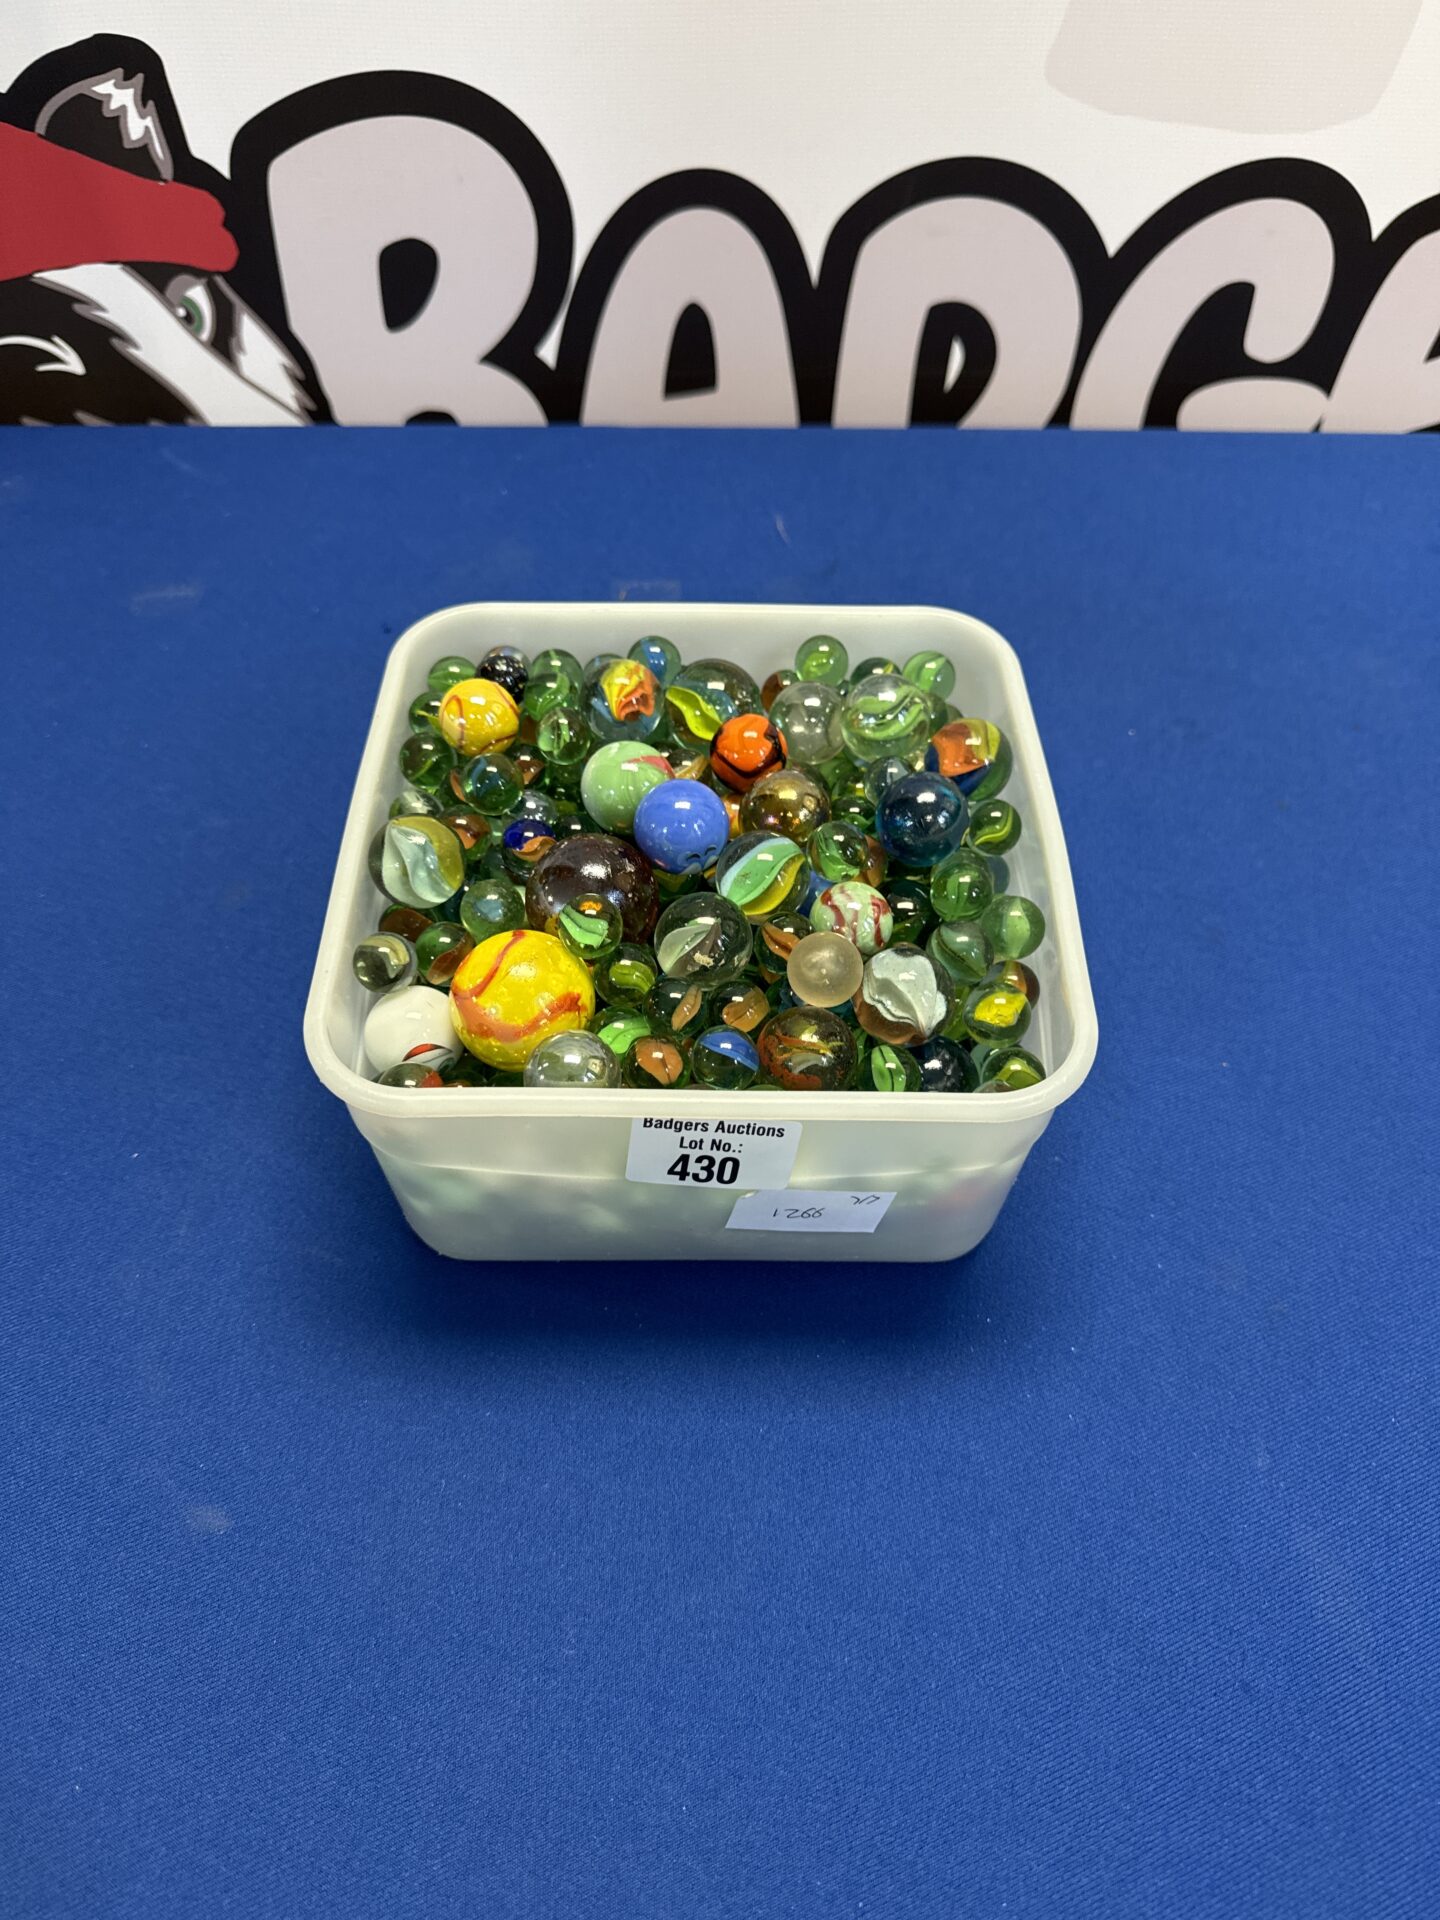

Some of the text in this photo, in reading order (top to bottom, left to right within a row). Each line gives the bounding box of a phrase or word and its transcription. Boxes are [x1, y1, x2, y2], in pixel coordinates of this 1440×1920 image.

[642, 1118, 786, 1138] Badgers Auctions
[679, 1136, 743, 1153] Lot No.:
[666, 1153, 741, 1185] 430
